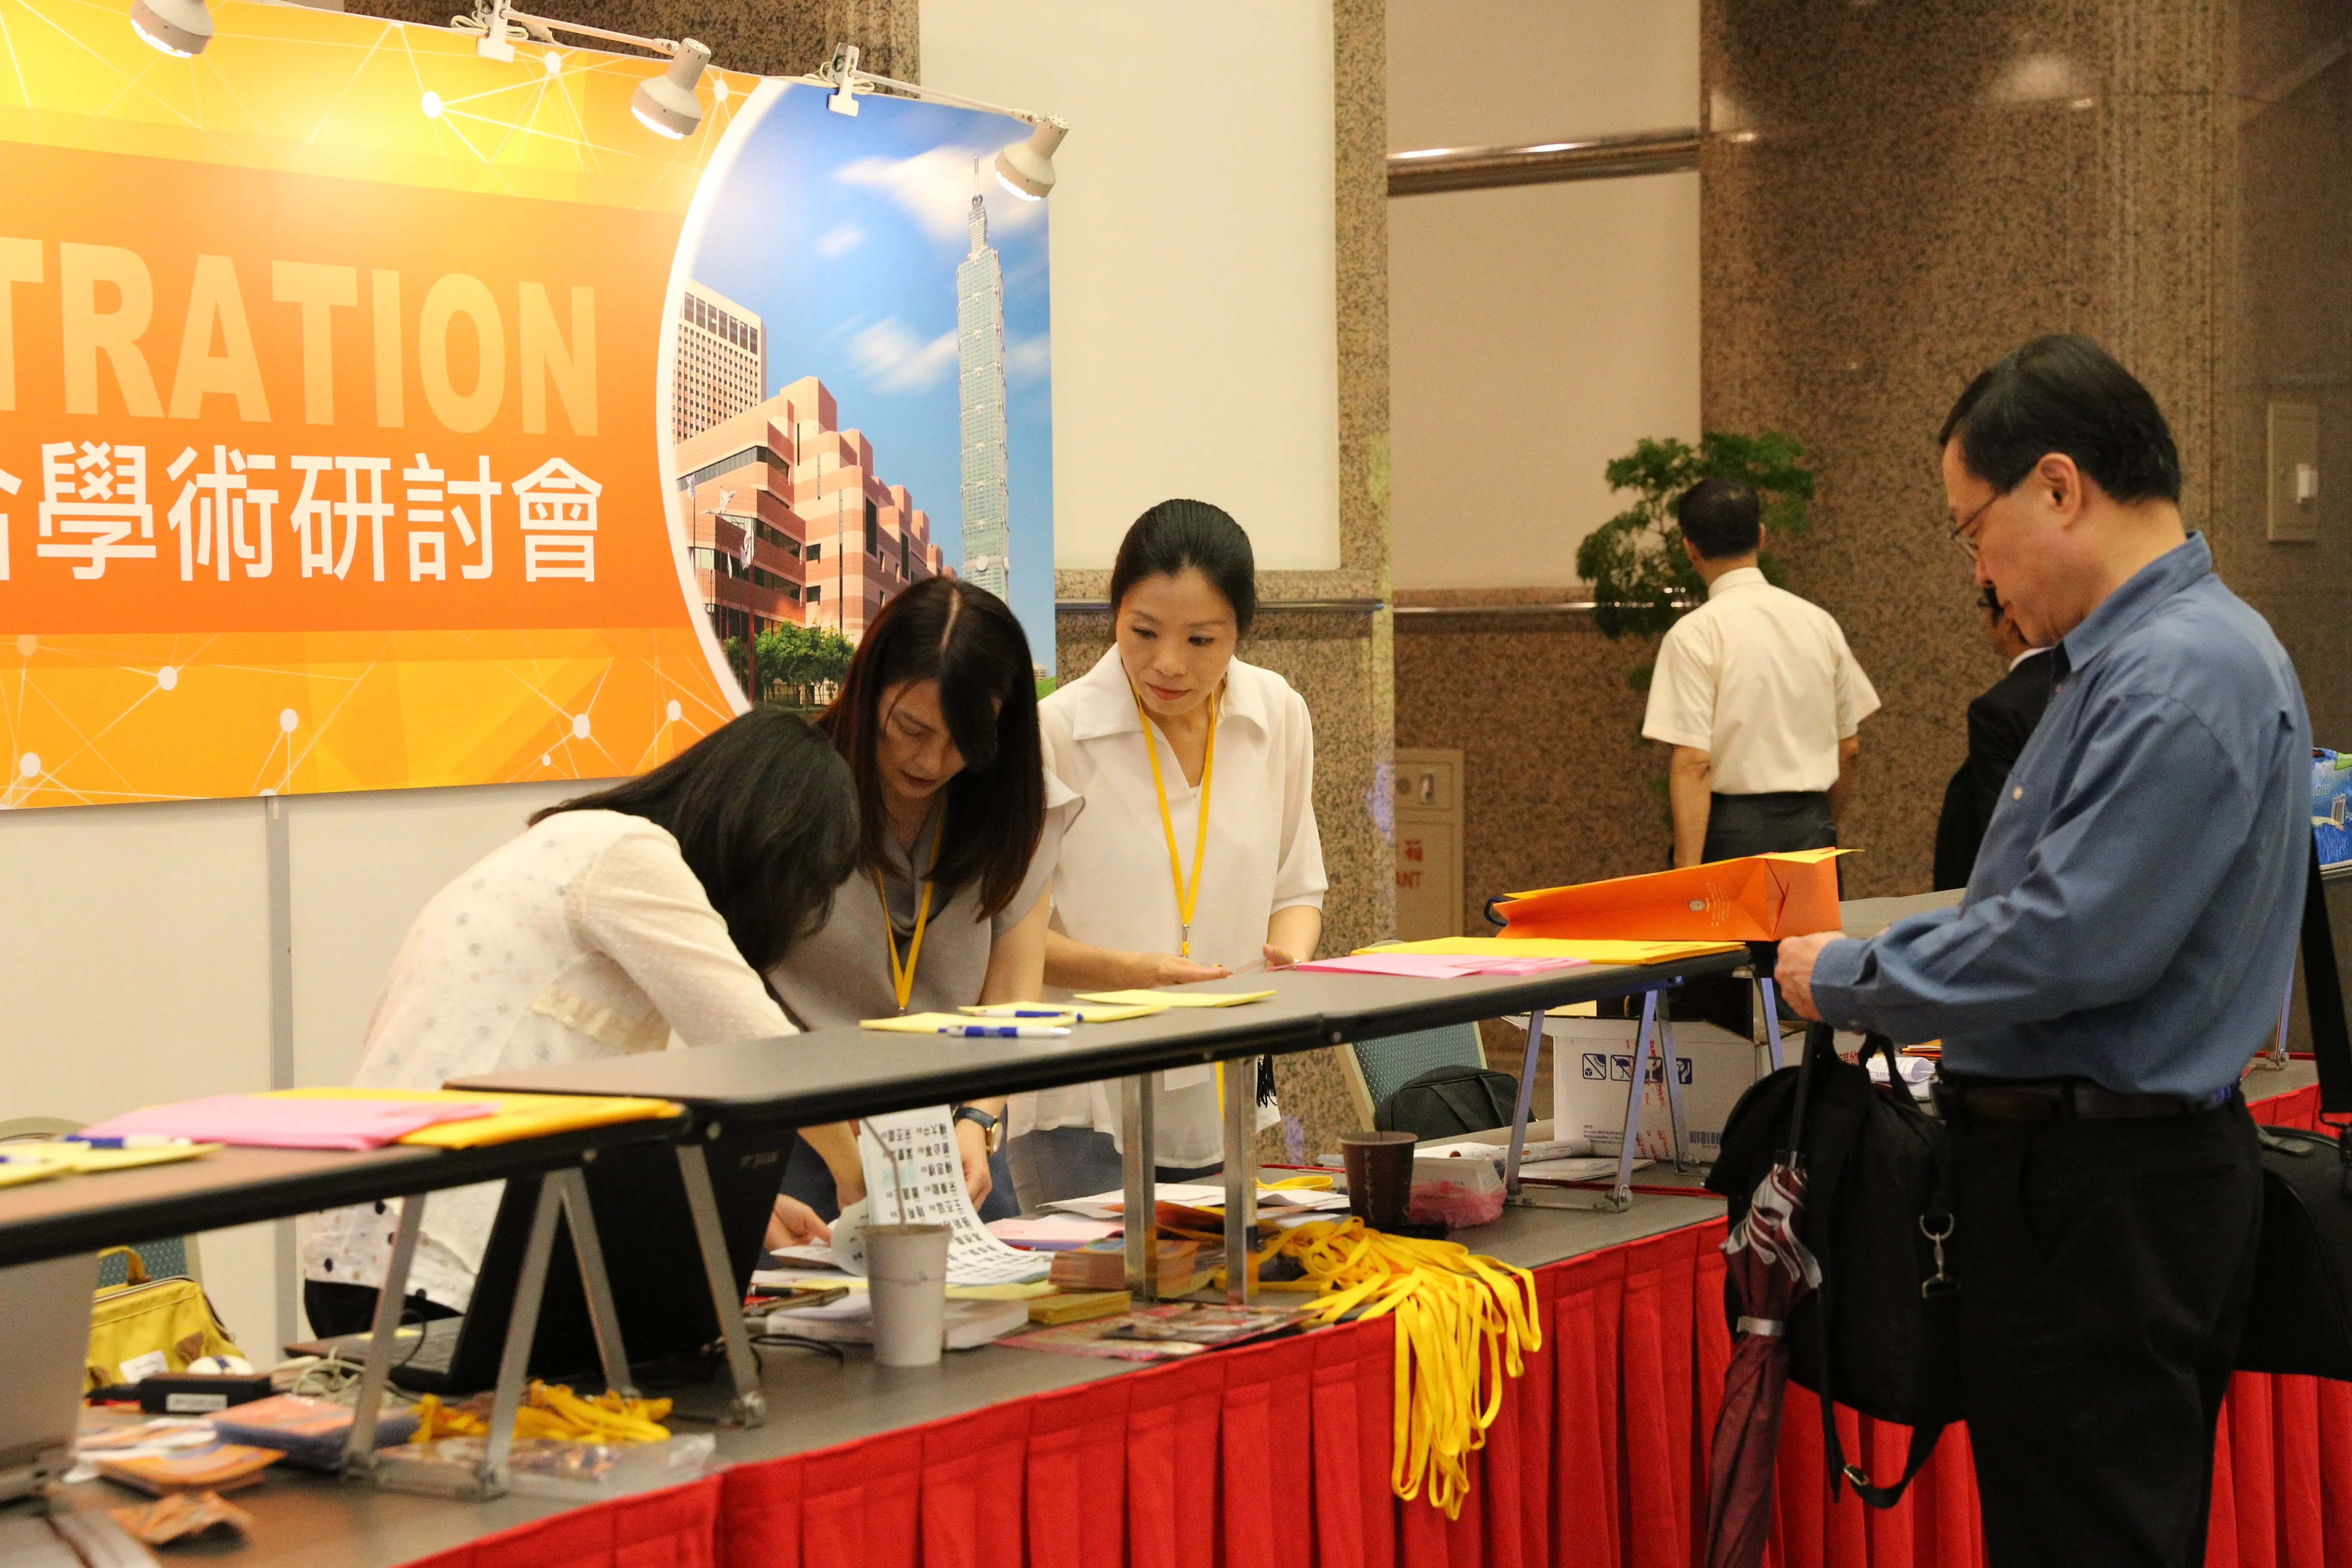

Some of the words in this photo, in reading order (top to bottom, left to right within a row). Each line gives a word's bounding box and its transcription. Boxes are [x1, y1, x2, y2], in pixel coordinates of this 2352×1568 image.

[0, 441, 603, 582] 學術研討會
